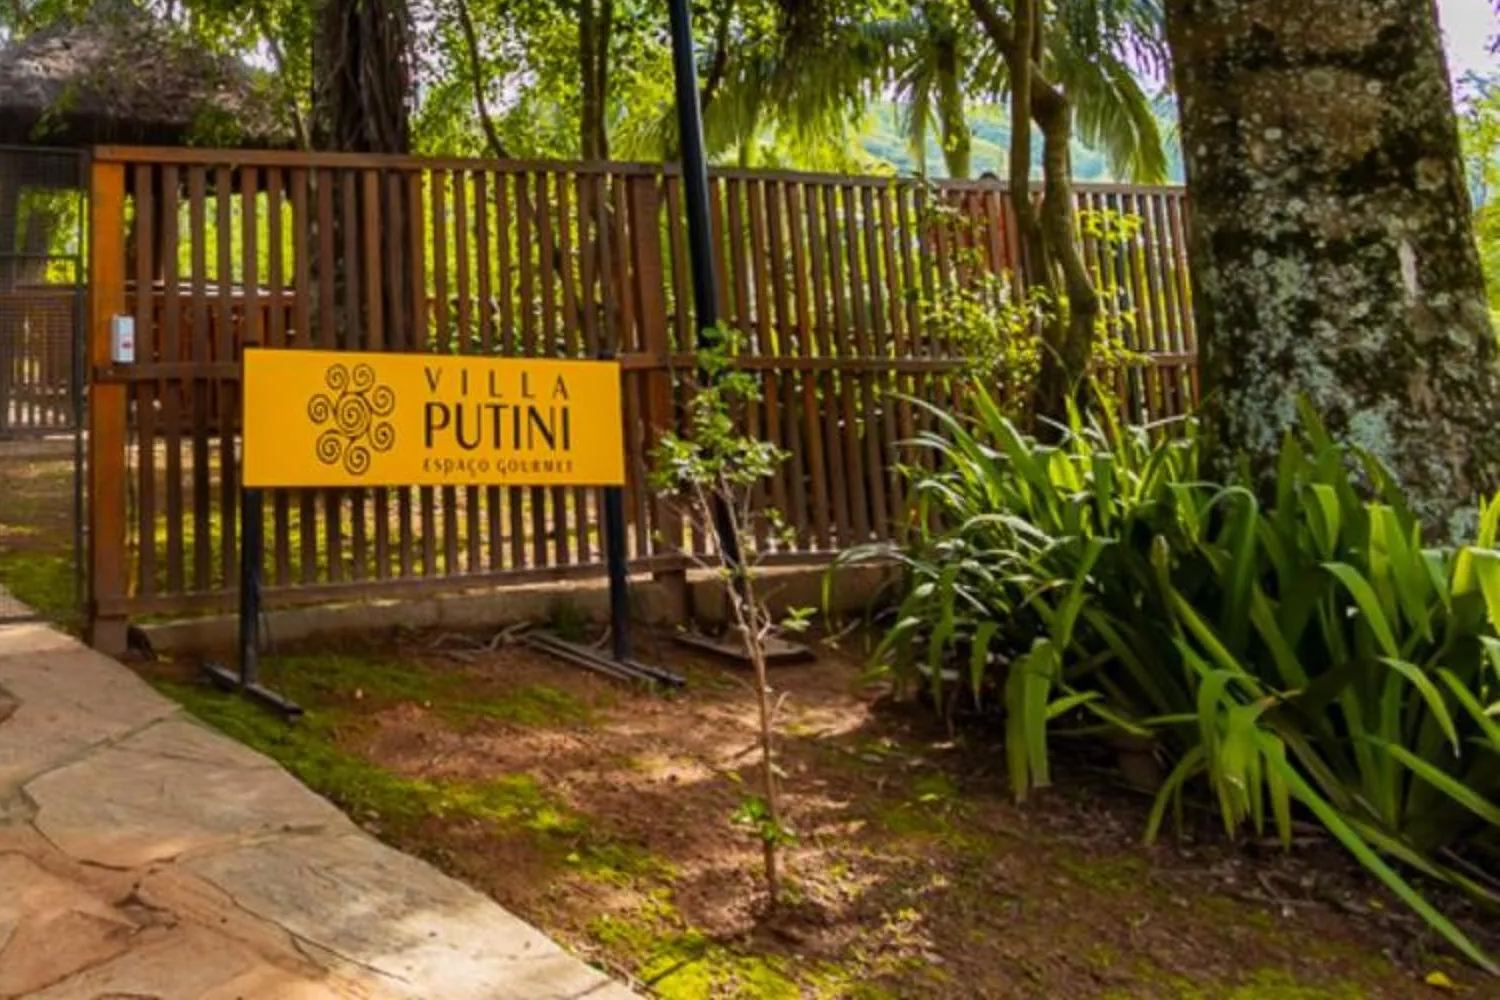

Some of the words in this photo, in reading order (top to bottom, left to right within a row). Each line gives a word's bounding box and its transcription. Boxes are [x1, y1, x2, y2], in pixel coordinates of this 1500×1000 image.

[424, 367, 569, 399] VILLA
[424, 403, 570, 451] PUTINI
[423, 458, 489, 477] ESPAÇO
